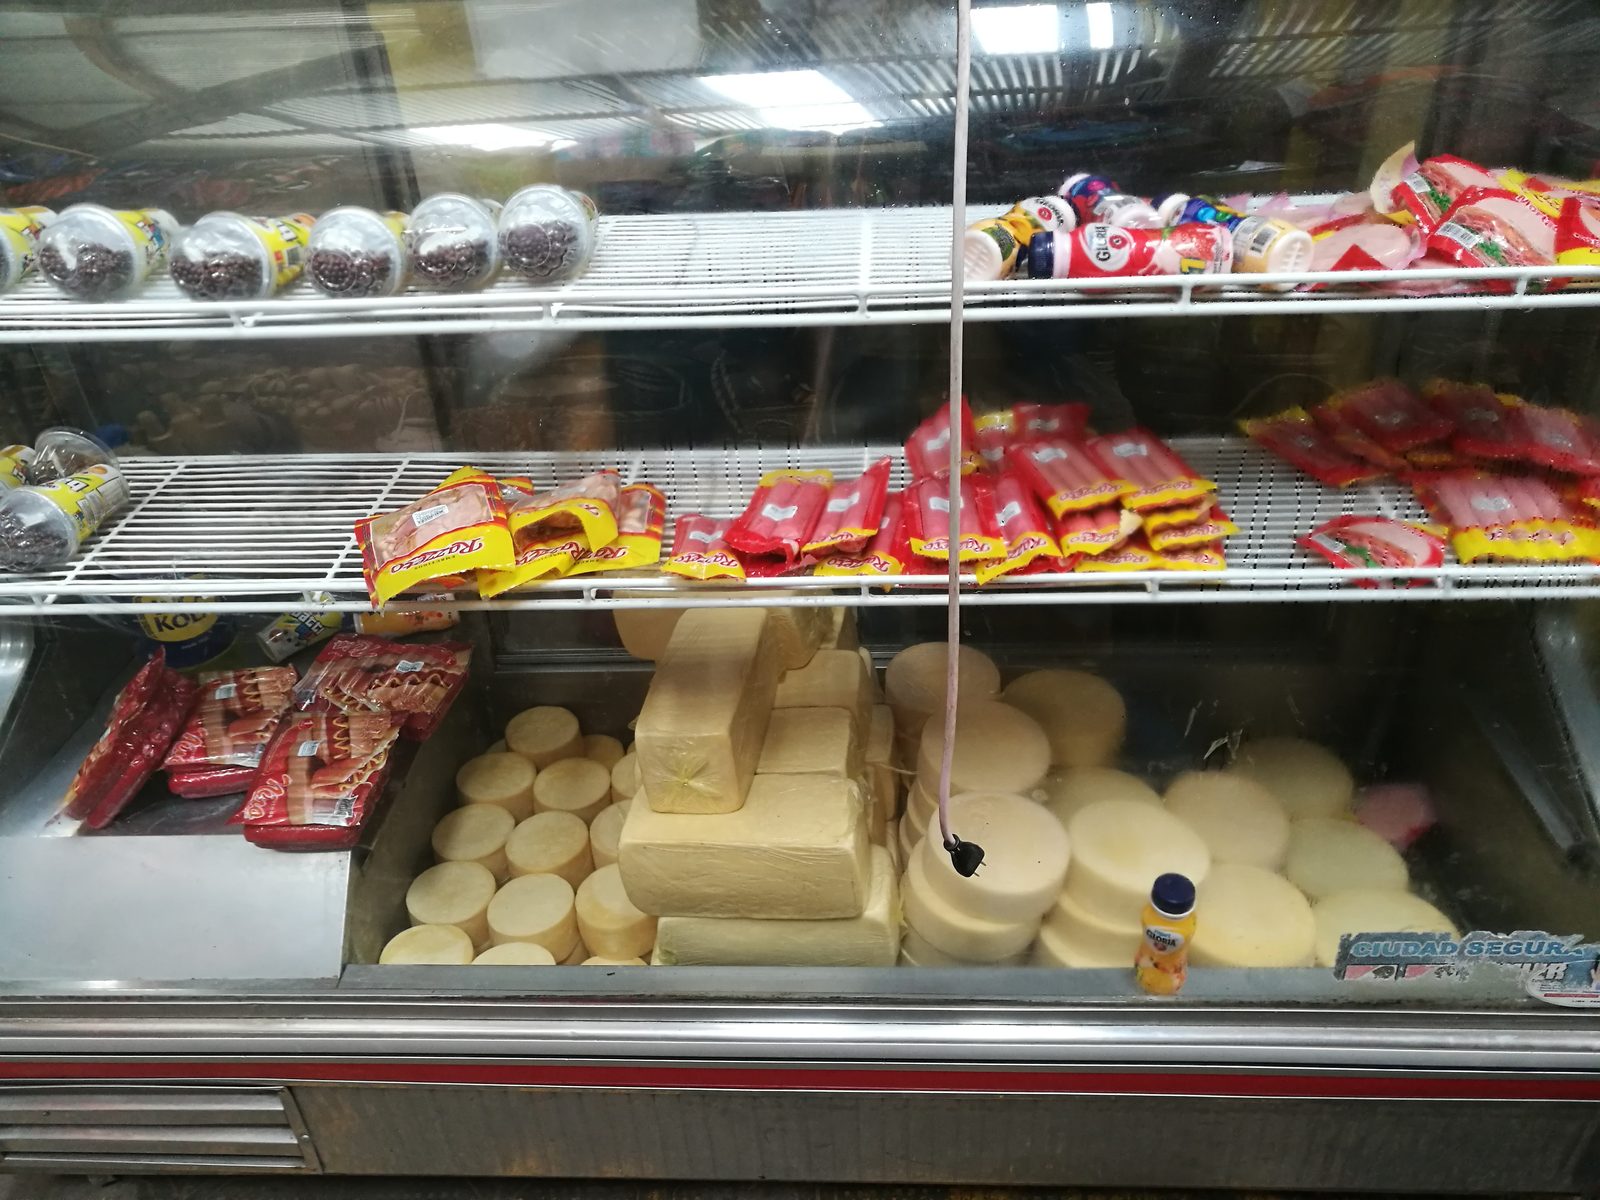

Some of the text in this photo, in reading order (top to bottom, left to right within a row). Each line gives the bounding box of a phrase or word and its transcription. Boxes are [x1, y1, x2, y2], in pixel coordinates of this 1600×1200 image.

[923, 537, 991, 553] Razeto
[390, 537, 484, 575] Razzeto
[673, 551, 738, 568] Razzeto
[1352, 940, 1458, 958] CIUDAD
